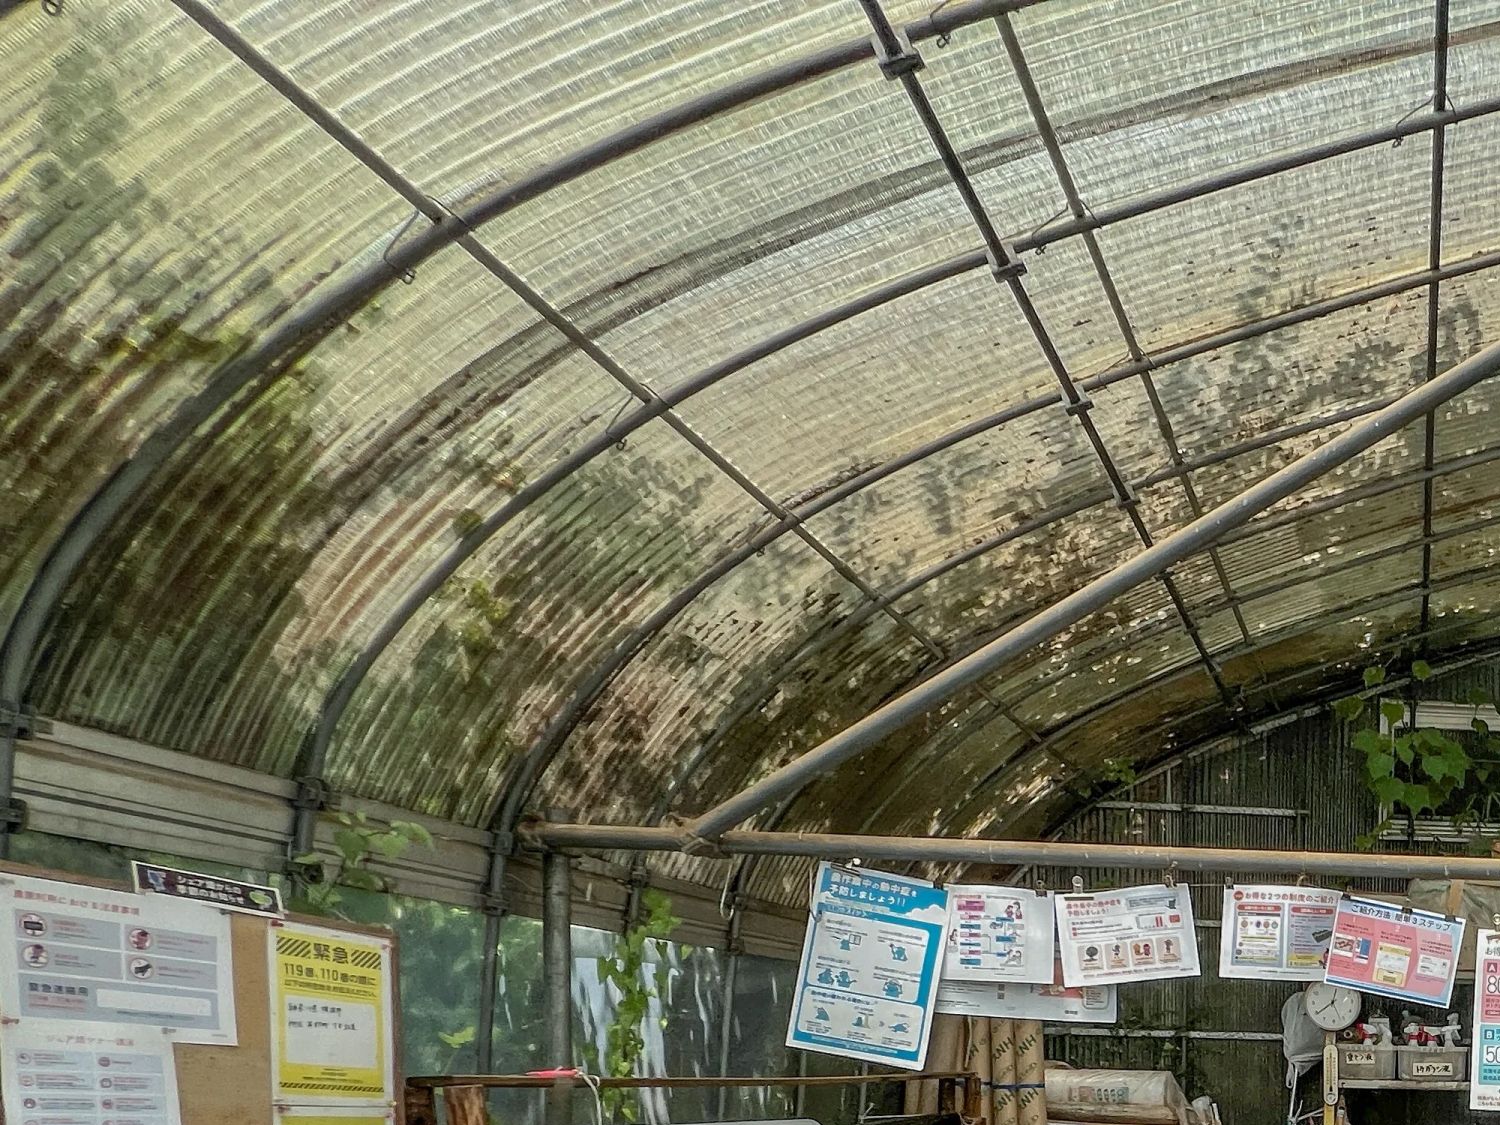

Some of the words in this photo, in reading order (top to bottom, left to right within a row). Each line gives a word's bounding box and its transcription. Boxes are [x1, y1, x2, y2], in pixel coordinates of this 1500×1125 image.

[1351, 904, 1391, 920] ご紹介方法
[313, 942, 350, 964] 緊急
